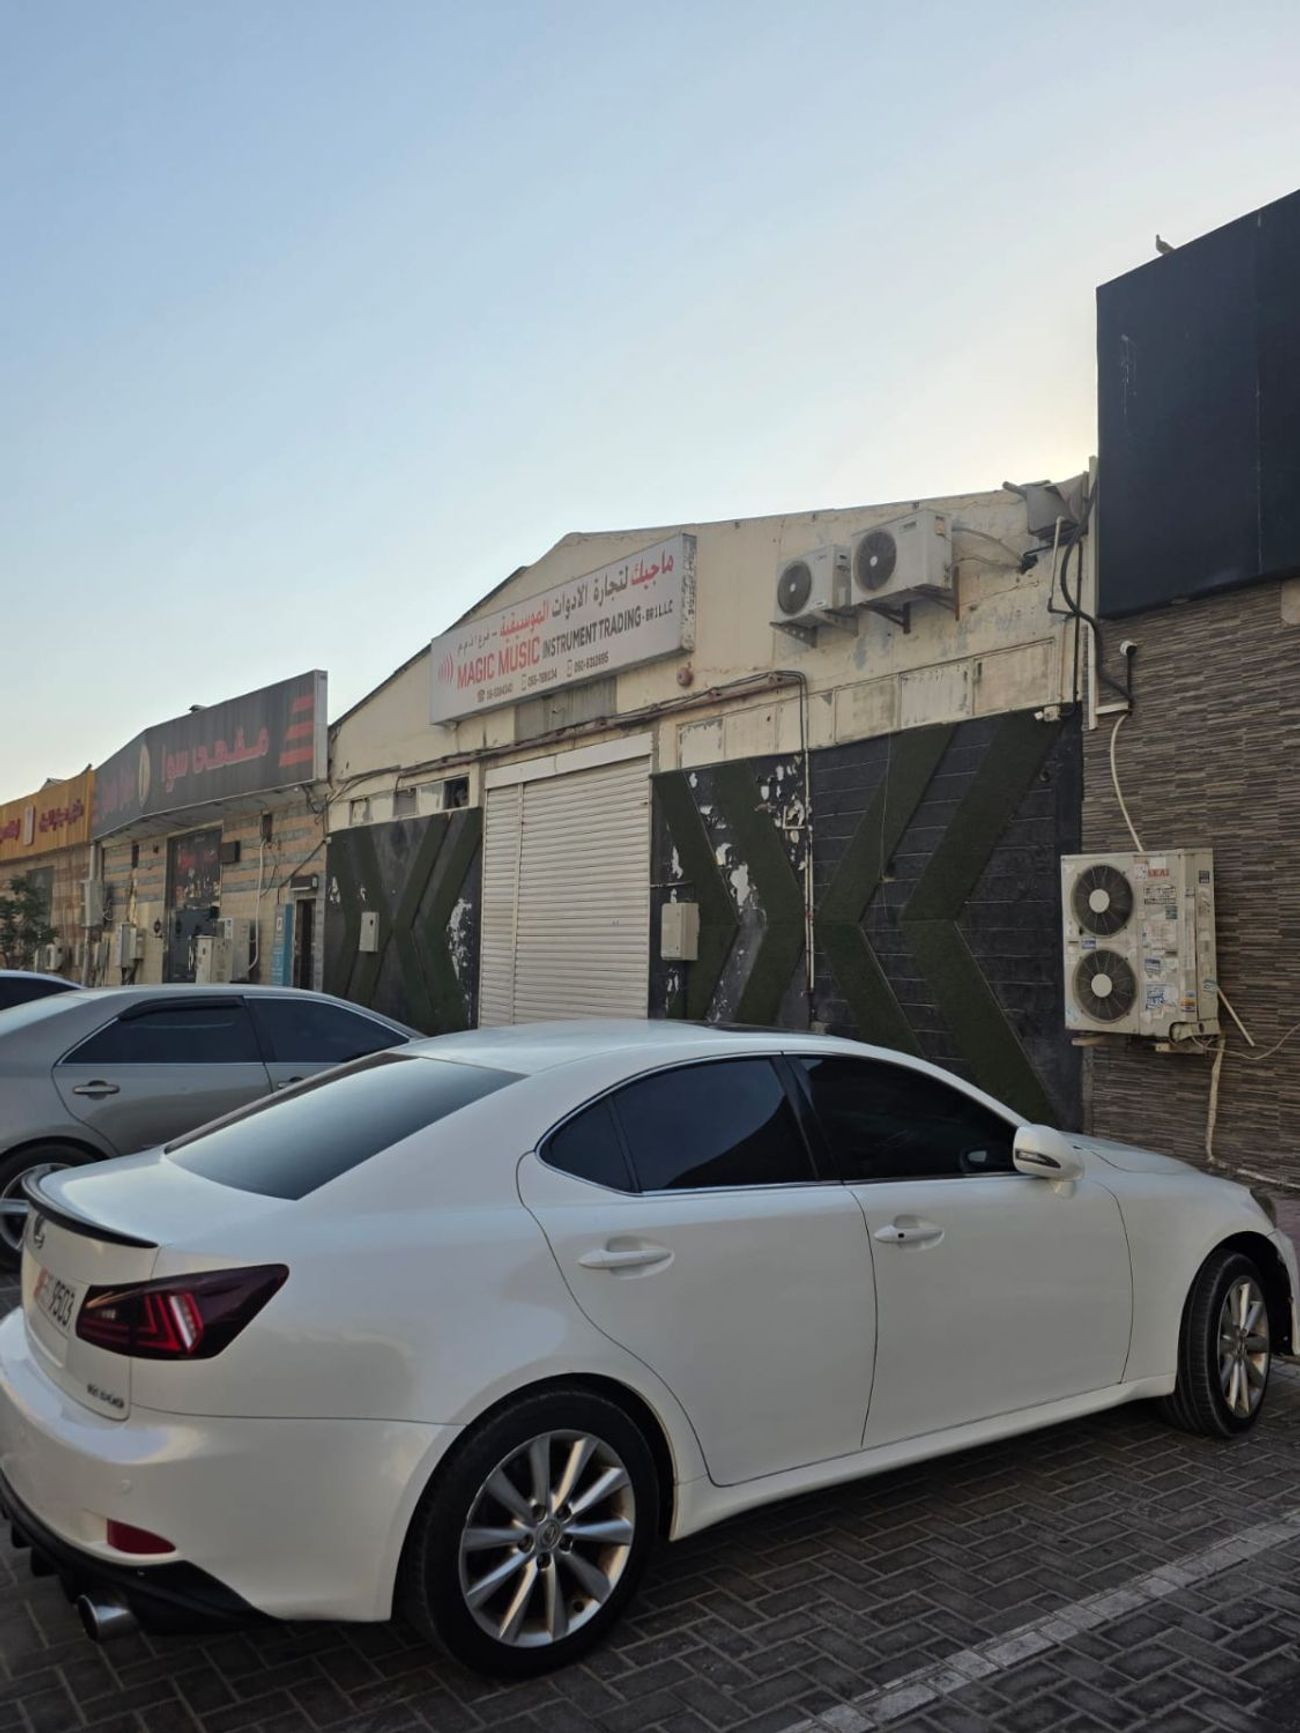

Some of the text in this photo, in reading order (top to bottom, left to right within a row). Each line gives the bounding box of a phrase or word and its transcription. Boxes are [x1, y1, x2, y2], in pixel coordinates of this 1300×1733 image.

[593, 565, 628, 606] لتجارة
[456, 653, 495, 689] MAGIC
[499, 636, 541, 675] MUSIC
[542, 623, 597, 659] INSTRUMENT
[599, 606, 641, 639] TRADING
